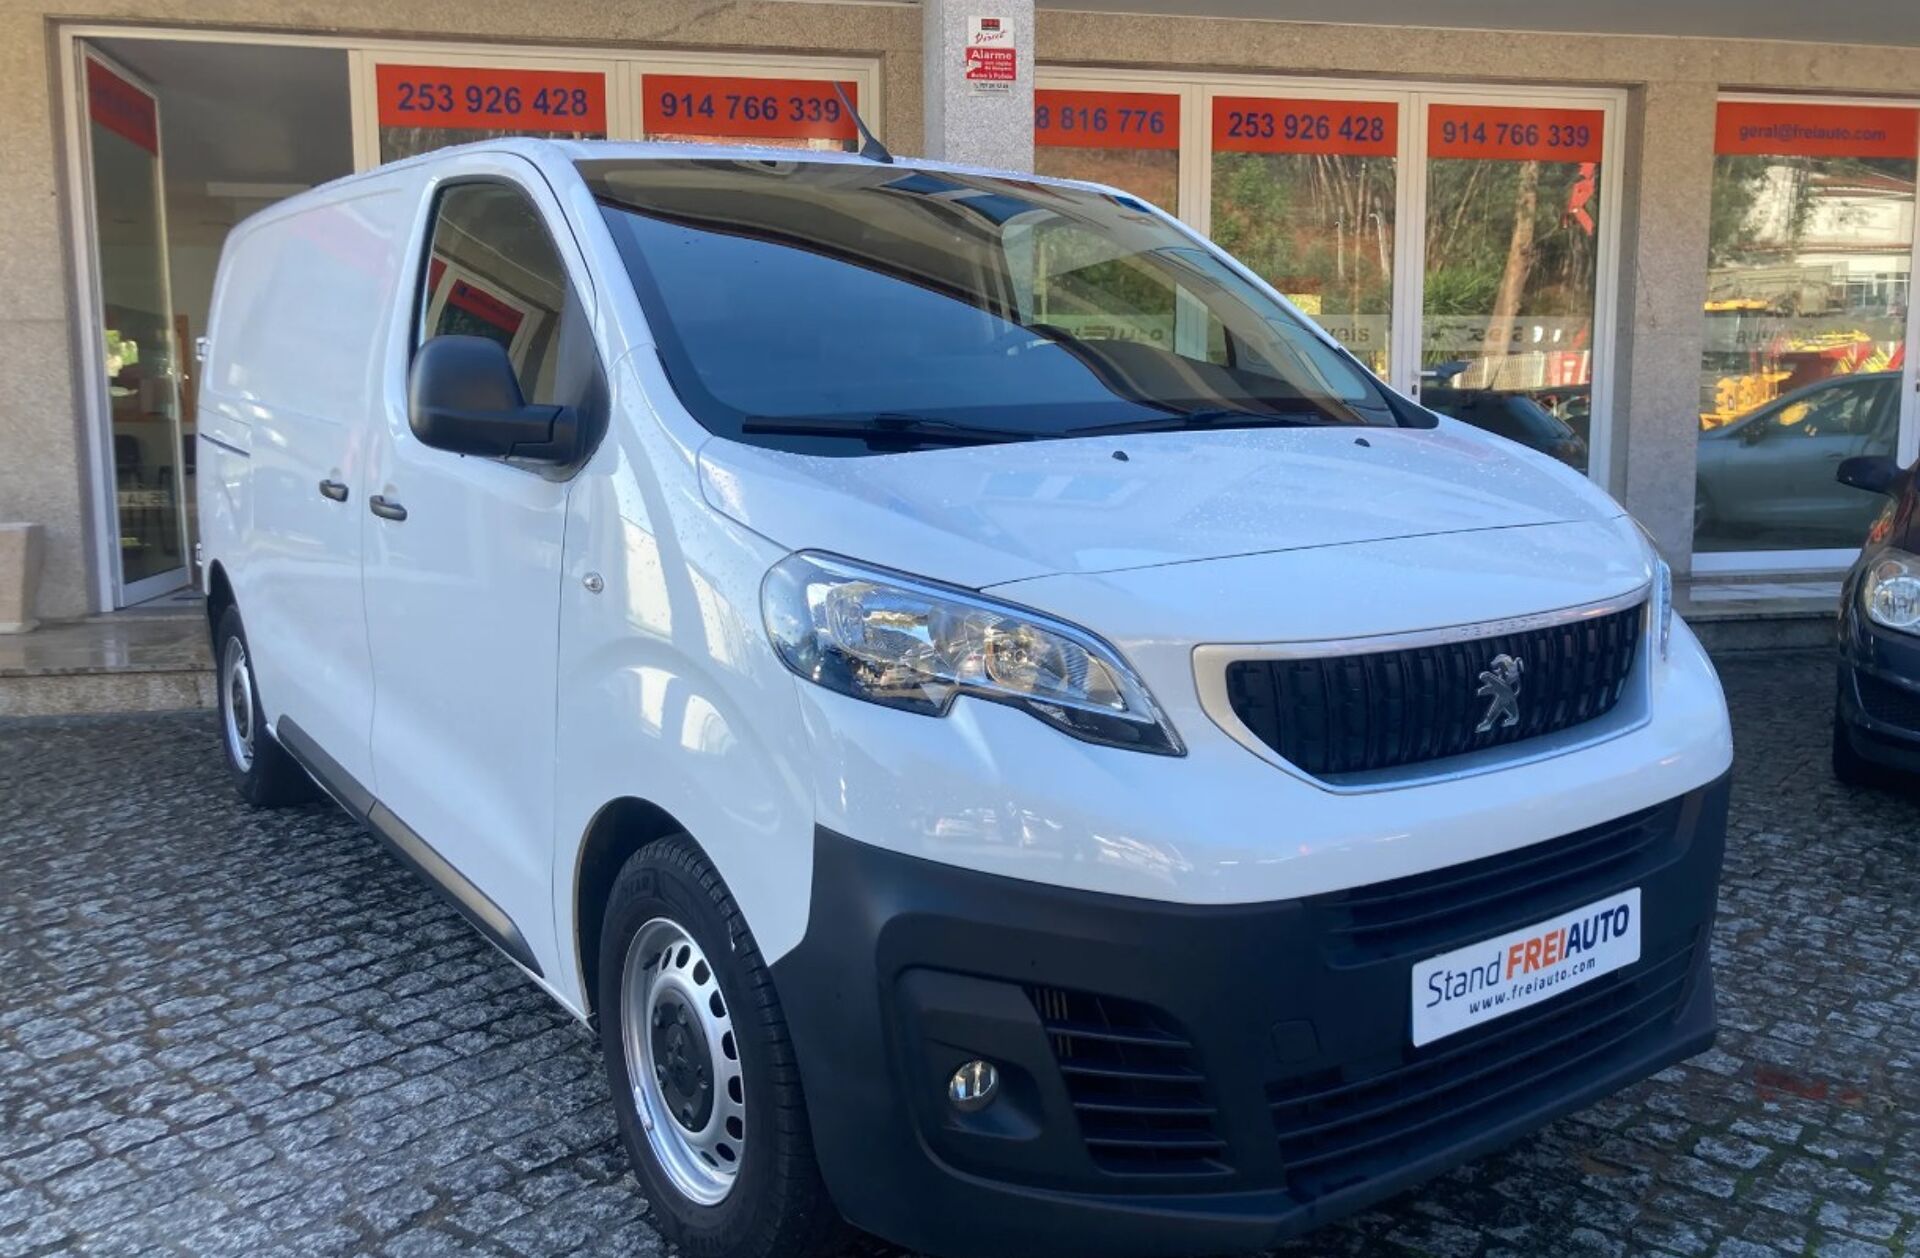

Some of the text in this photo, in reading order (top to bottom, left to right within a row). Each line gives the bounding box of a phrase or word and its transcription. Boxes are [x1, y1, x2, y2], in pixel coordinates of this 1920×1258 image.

[971, 50, 1012, 60] Alarme
[397, 81, 588, 117] 253 926 428
[661, 92, 841, 123] 914 766 339
[1060, 106, 1108, 132] 816
[1117, 109, 1165, 135] 776
[1228, 111, 1384, 142] 253 926 428
[1442, 121, 1591, 148] 914 766 339
[1739, 123, 1887, 142] geral@freiauto.com
[1427, 904, 1629, 1008] Stand FREIAUTO
[1469, 957, 1596, 1014] www.freiauto.com
